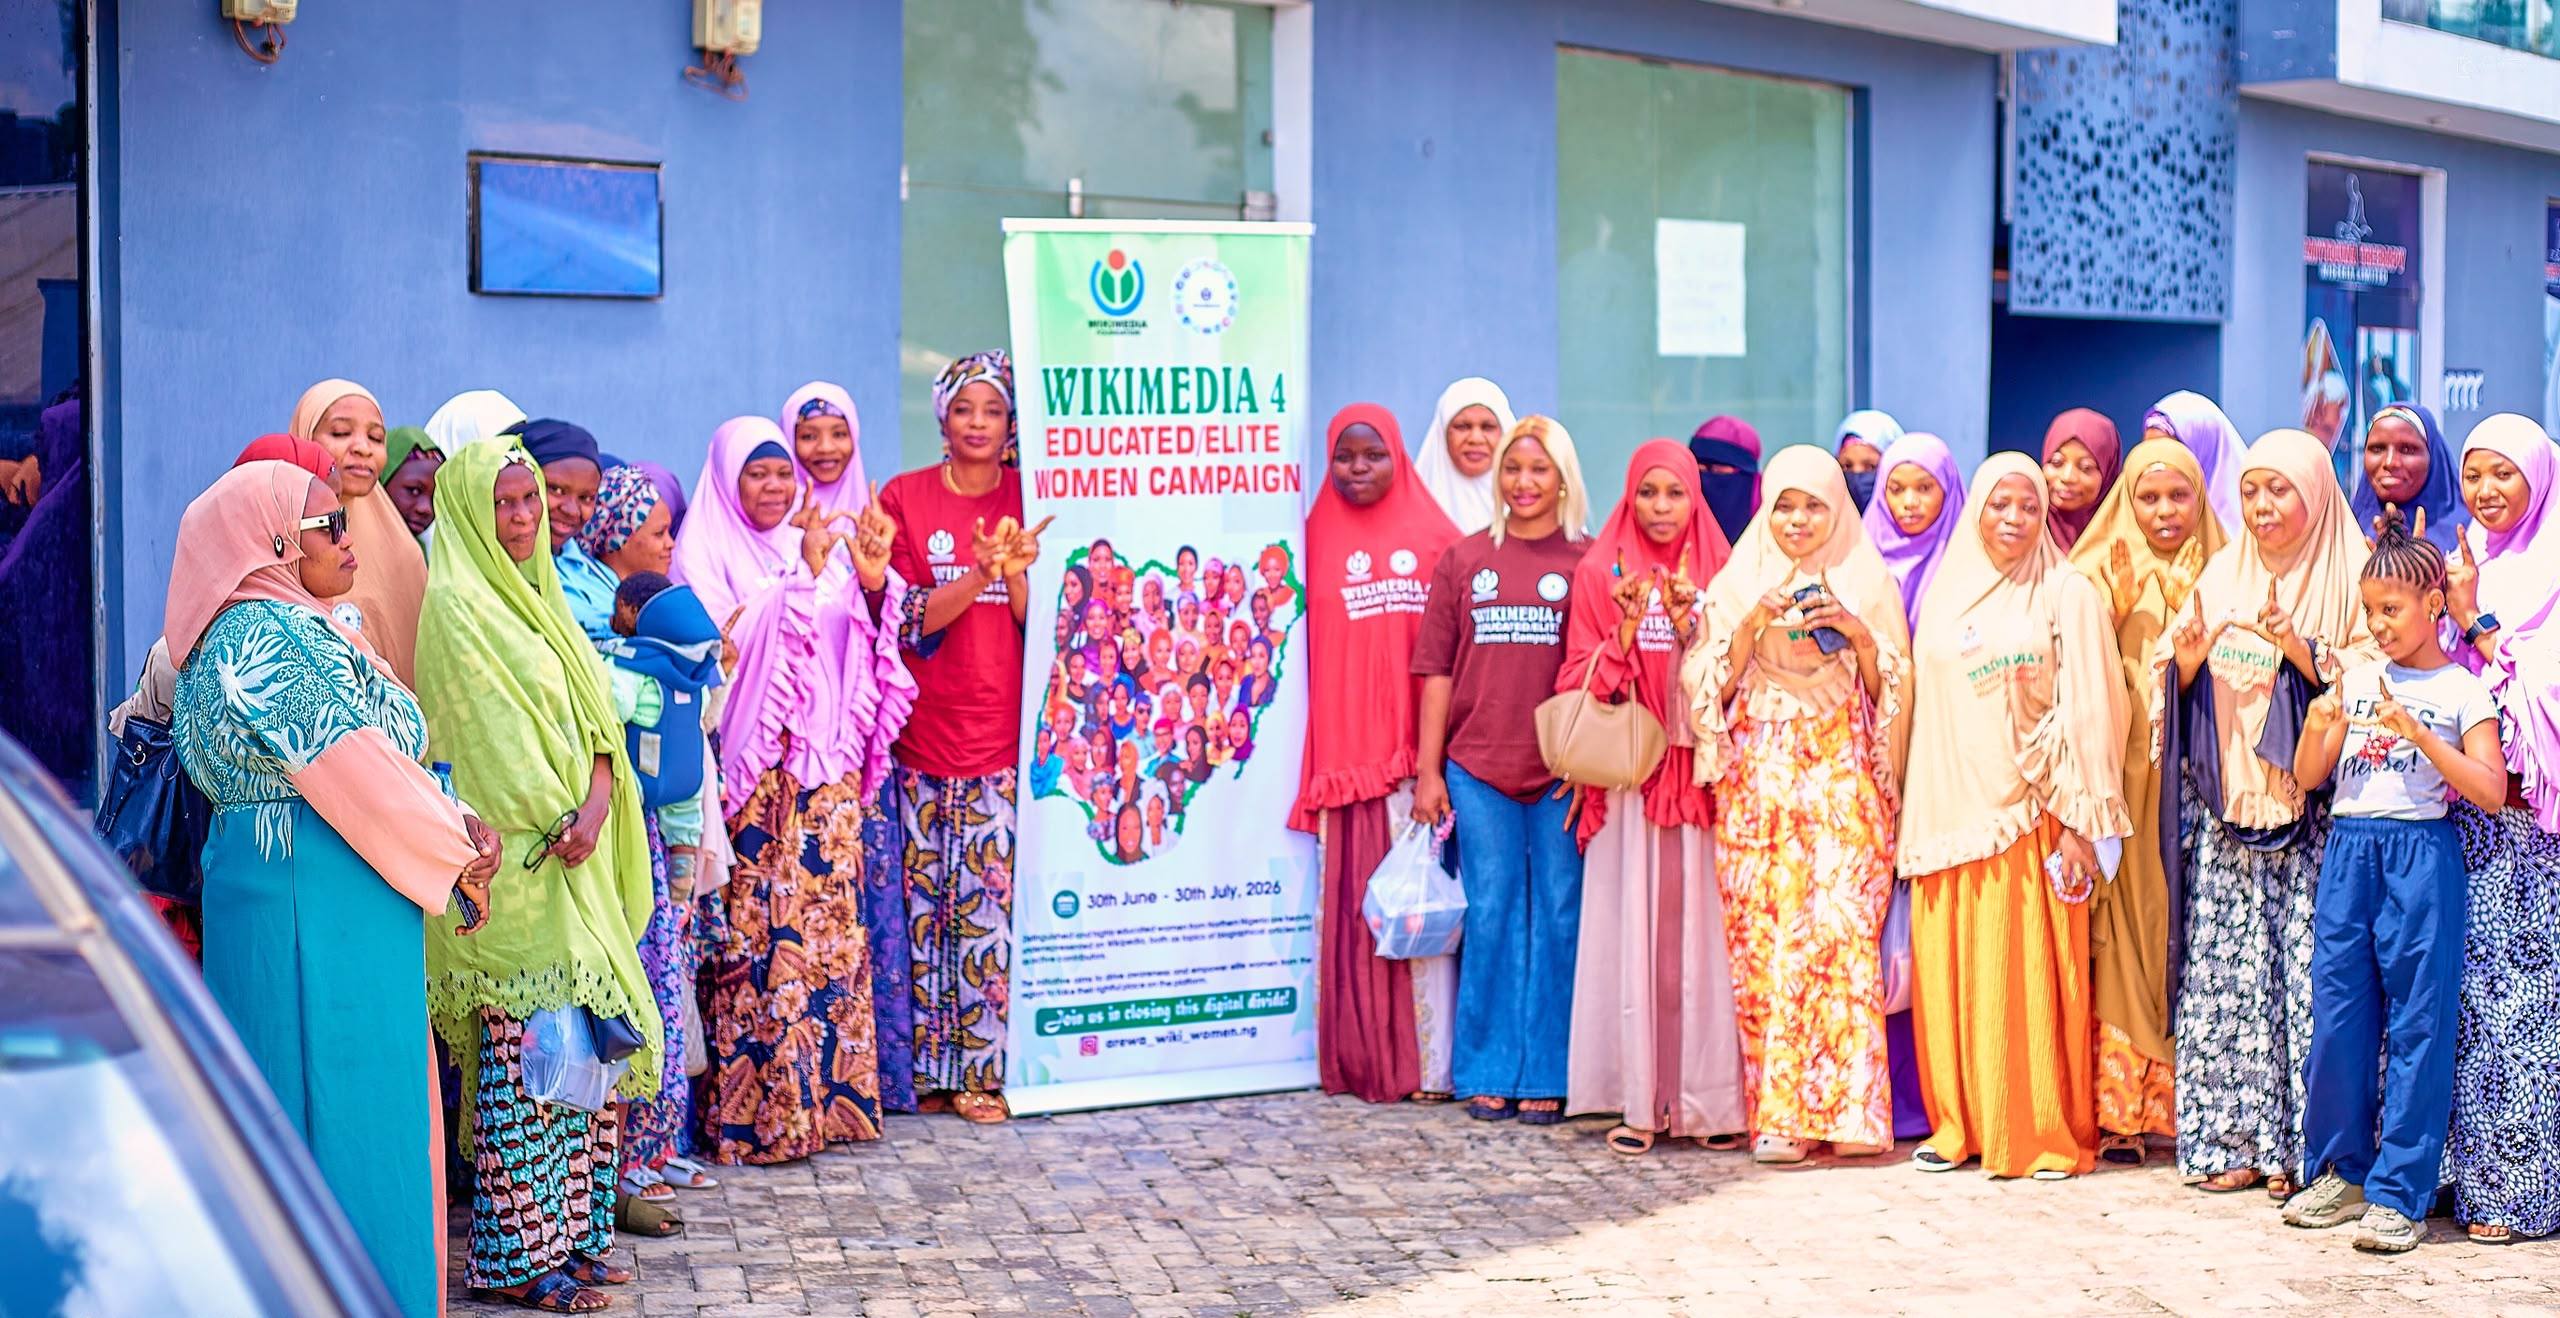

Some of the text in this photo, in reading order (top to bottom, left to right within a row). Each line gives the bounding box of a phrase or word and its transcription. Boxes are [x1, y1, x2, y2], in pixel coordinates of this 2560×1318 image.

[1042, 366, 1286, 416] WIKIMEDIA 4
[1046, 424, 1280, 458] EDUCATED/ELITE
[1035, 464, 1301, 499] WOMEN CAMPAIGN
[1341, 577, 1424, 601] WIKIMEDIA
[1470, 605, 1554, 624] WIKIMEDIA
[1087, 893, 1118, 909] 30th
[1121, 891, 1157, 906] June
[1175, 886, 1207, 902] 30th
[1246, 881, 1282, 896] 2026
[1043, 989, 1291, 1034] Join us in closing this digital divide!
[1105, 1024, 1258, 1049] arewa_wiki_women.ng
